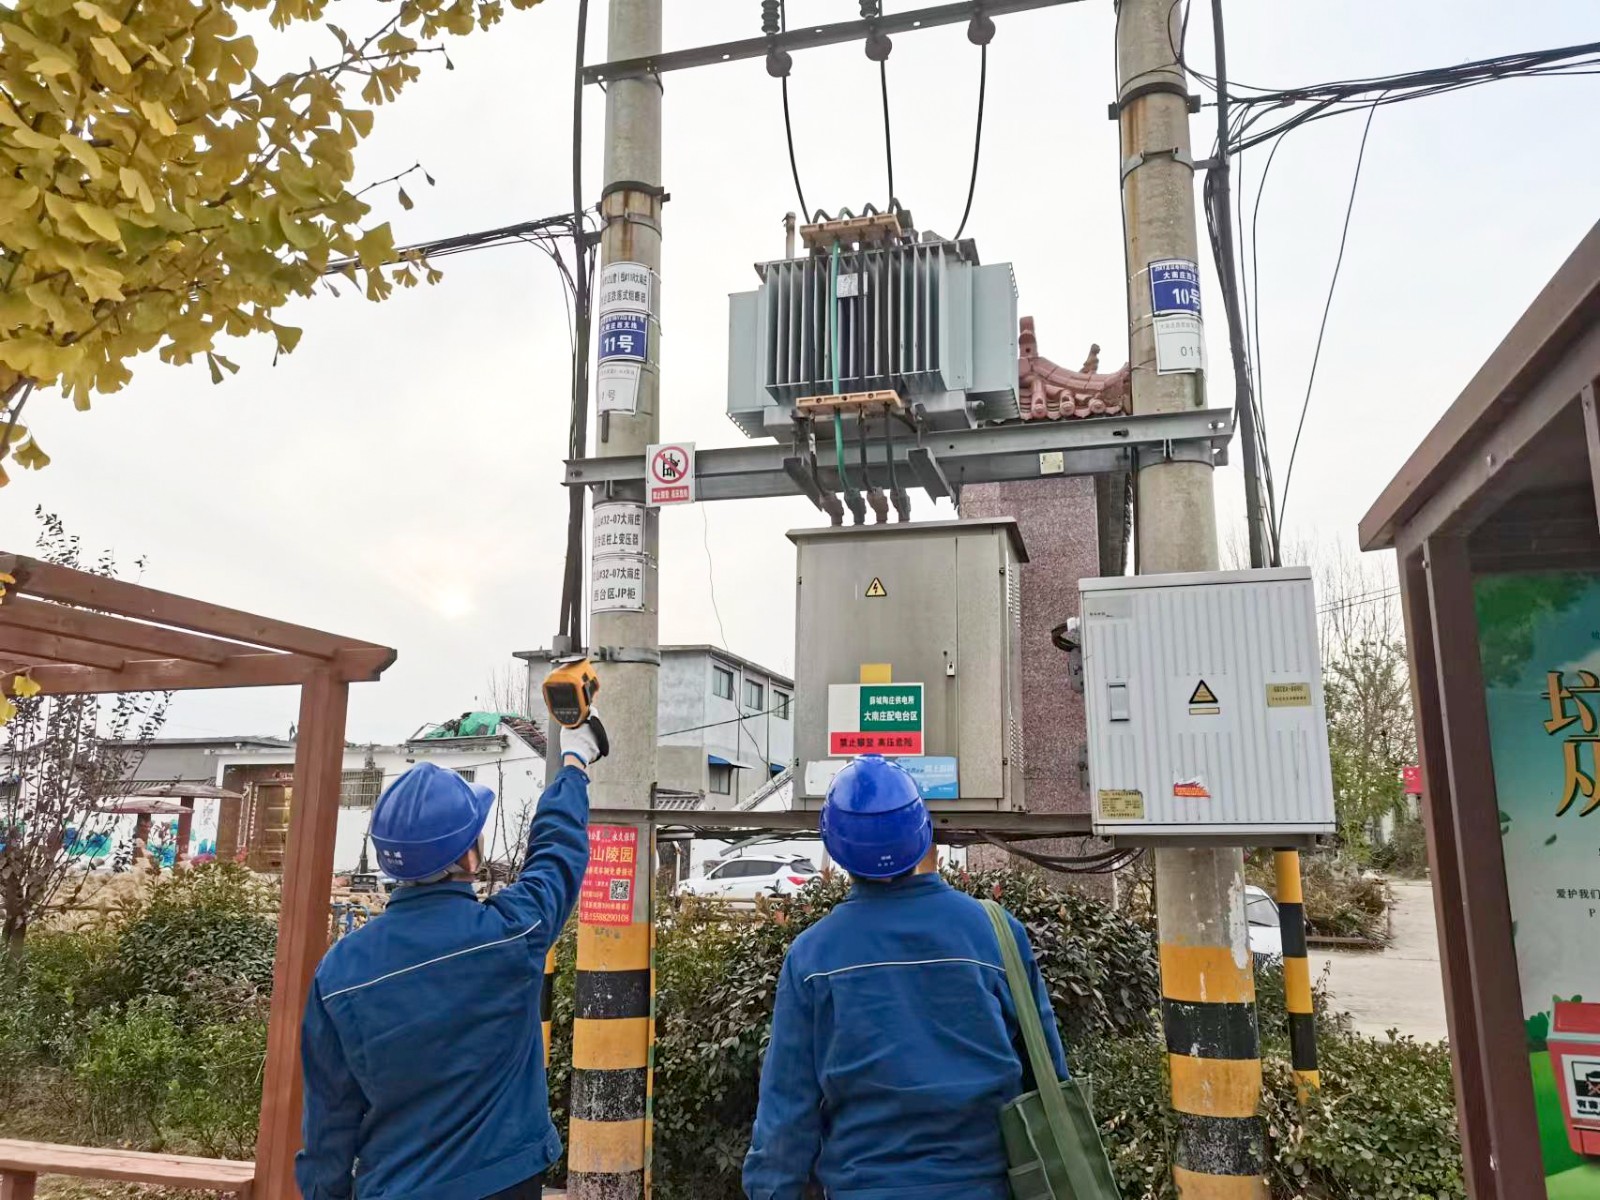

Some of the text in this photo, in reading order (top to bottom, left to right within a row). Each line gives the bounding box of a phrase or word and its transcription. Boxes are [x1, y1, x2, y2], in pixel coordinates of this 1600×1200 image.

[1172, 287, 1200, 310] 10号
[604, 334, 634, 353] 11号
[864, 711, 918, 721] 大南庄配电台区
